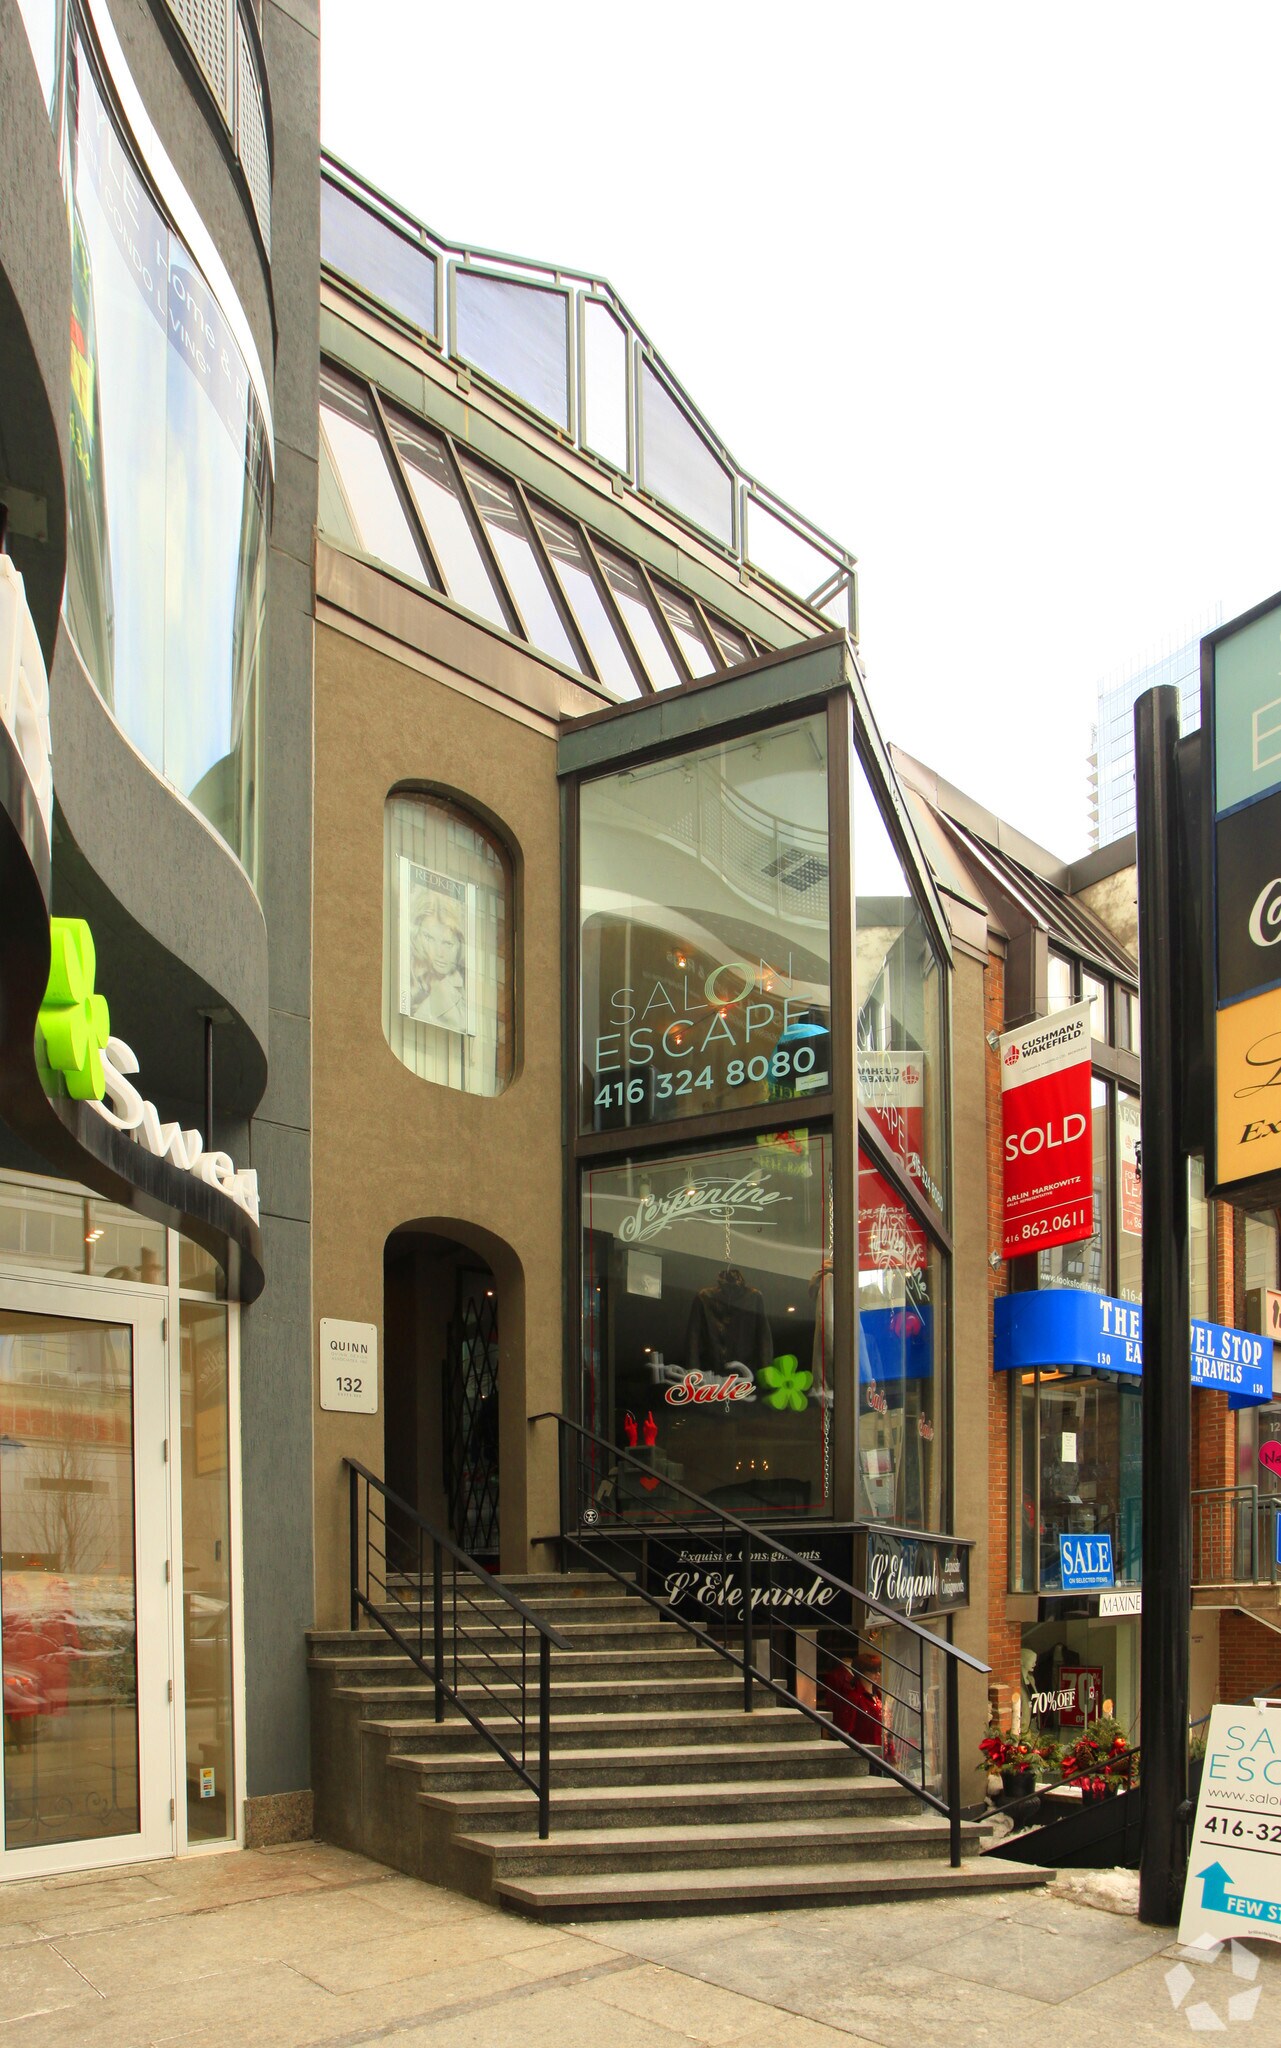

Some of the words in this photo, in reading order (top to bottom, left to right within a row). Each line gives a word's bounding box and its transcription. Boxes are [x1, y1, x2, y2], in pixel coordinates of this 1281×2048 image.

[415, 868, 462, 897] REDKEN
[610, 952, 793, 1025] SALON
[596, 994, 813, 1073] ESCAPE
[1021, 1023, 1075, 1051] CUSHMAN
[1076, 1020, 1084, 1030] &
[1022, 1030, 1082, 1059] WAKEFIELD
[594, 1078, 645, 1109] 416
[655, 1065, 715, 1099] 324
[726, 1046, 815, 1086] 8080
[1005, 1113, 1087, 1162] SOLD
[1006, 1191, 1029, 1203] ARLIN
[1031, 1175, 1081, 1196] MARKOWITZ
[617, 1167, 794, 1243] Serpentine
[1005, 1234, 1020, 1244] 416
[1022, 1209, 1085, 1239] 862.0611
[1100, 1298, 1140, 1339] THE
[1221, 1331, 1262, 1366] STOP
[330, 1340, 368, 1354] QUINN
[1097, 1352, 1111, 1366] 130
[336, 1376, 363, 1393] 132
[1195, 1356, 1243, 1384] TRAVELS
[664, 1371, 757, 1405] Sale
[1253, 1383, 1264, 1394] 130
[1062, 1541, 1111, 1575] SALE
[1102, 1594, 1141, 1613] MAXINE
[1031, 1690, 1057, 1714] 70%
[1057, 1690, 1076, 1709] OFF
[1227, 1896, 1264, 1917] FEW
